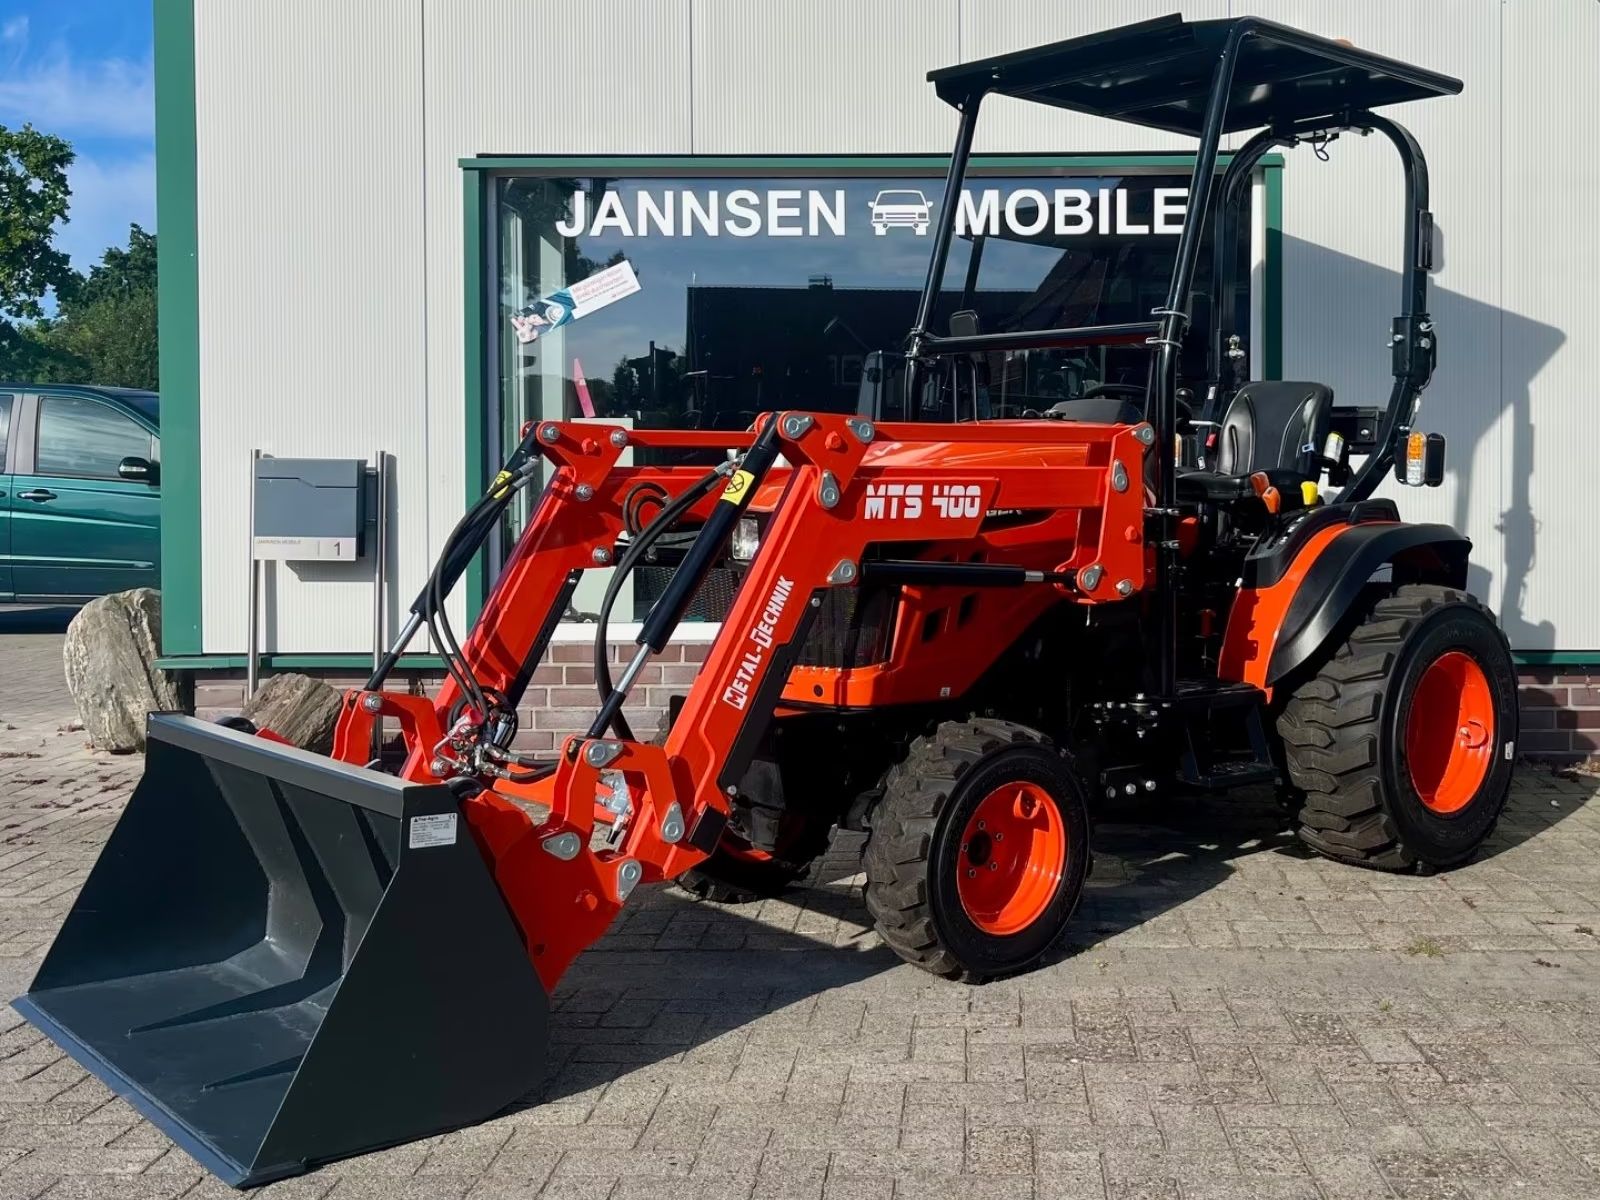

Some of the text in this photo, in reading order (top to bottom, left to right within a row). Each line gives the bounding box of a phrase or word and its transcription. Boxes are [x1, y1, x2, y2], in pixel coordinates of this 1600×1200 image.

[555, 187, 1189, 237] JANNSEN MOBILE
[864, 484, 981, 519] MTS 400
[334, 541, 340, 556] 1
